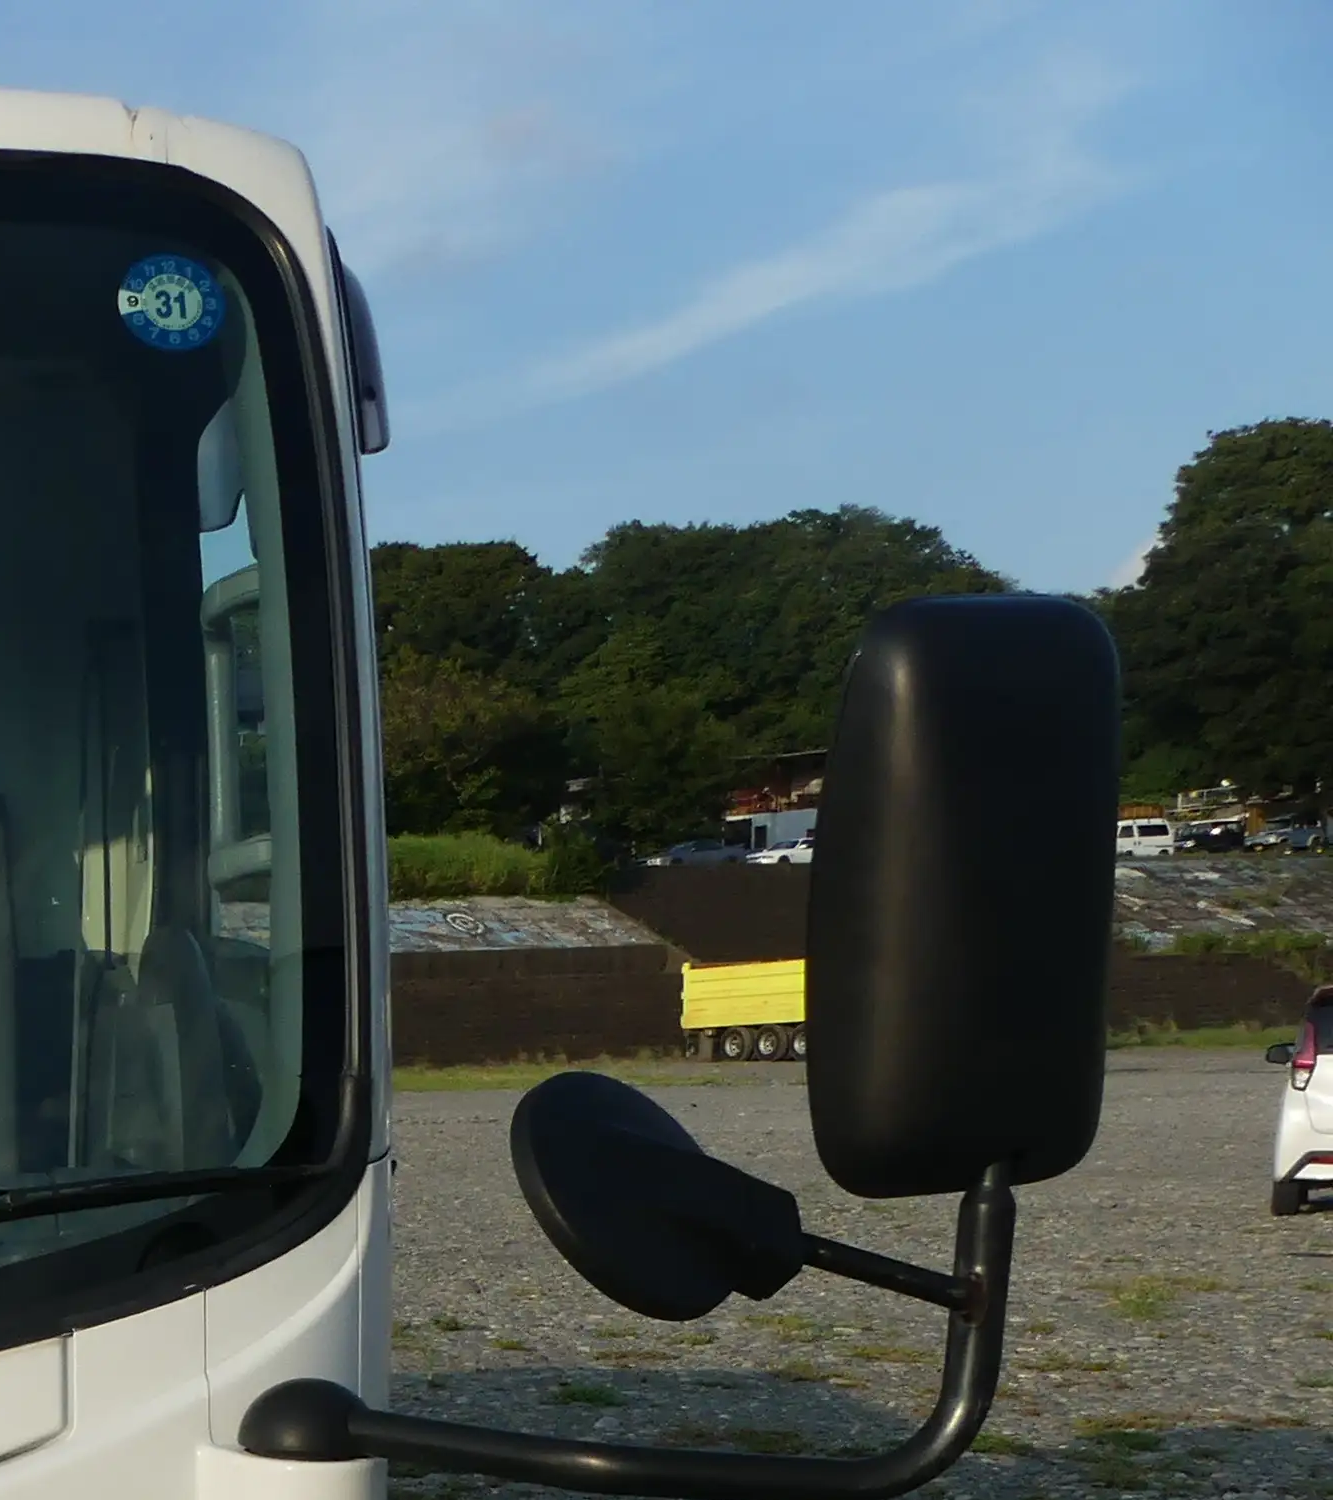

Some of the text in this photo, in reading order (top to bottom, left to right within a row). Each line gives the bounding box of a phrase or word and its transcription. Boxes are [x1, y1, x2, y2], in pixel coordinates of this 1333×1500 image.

[144, 265, 155, 276] 11
[161, 260, 175, 272] 12
[199, 280, 210, 292] 2
[127, 295, 139, 307] 9
[155, 290, 187, 319] 31
[201, 316, 213, 327] 4
[149, 327, 160, 339] 7
[170, 332, 181, 344] 6
